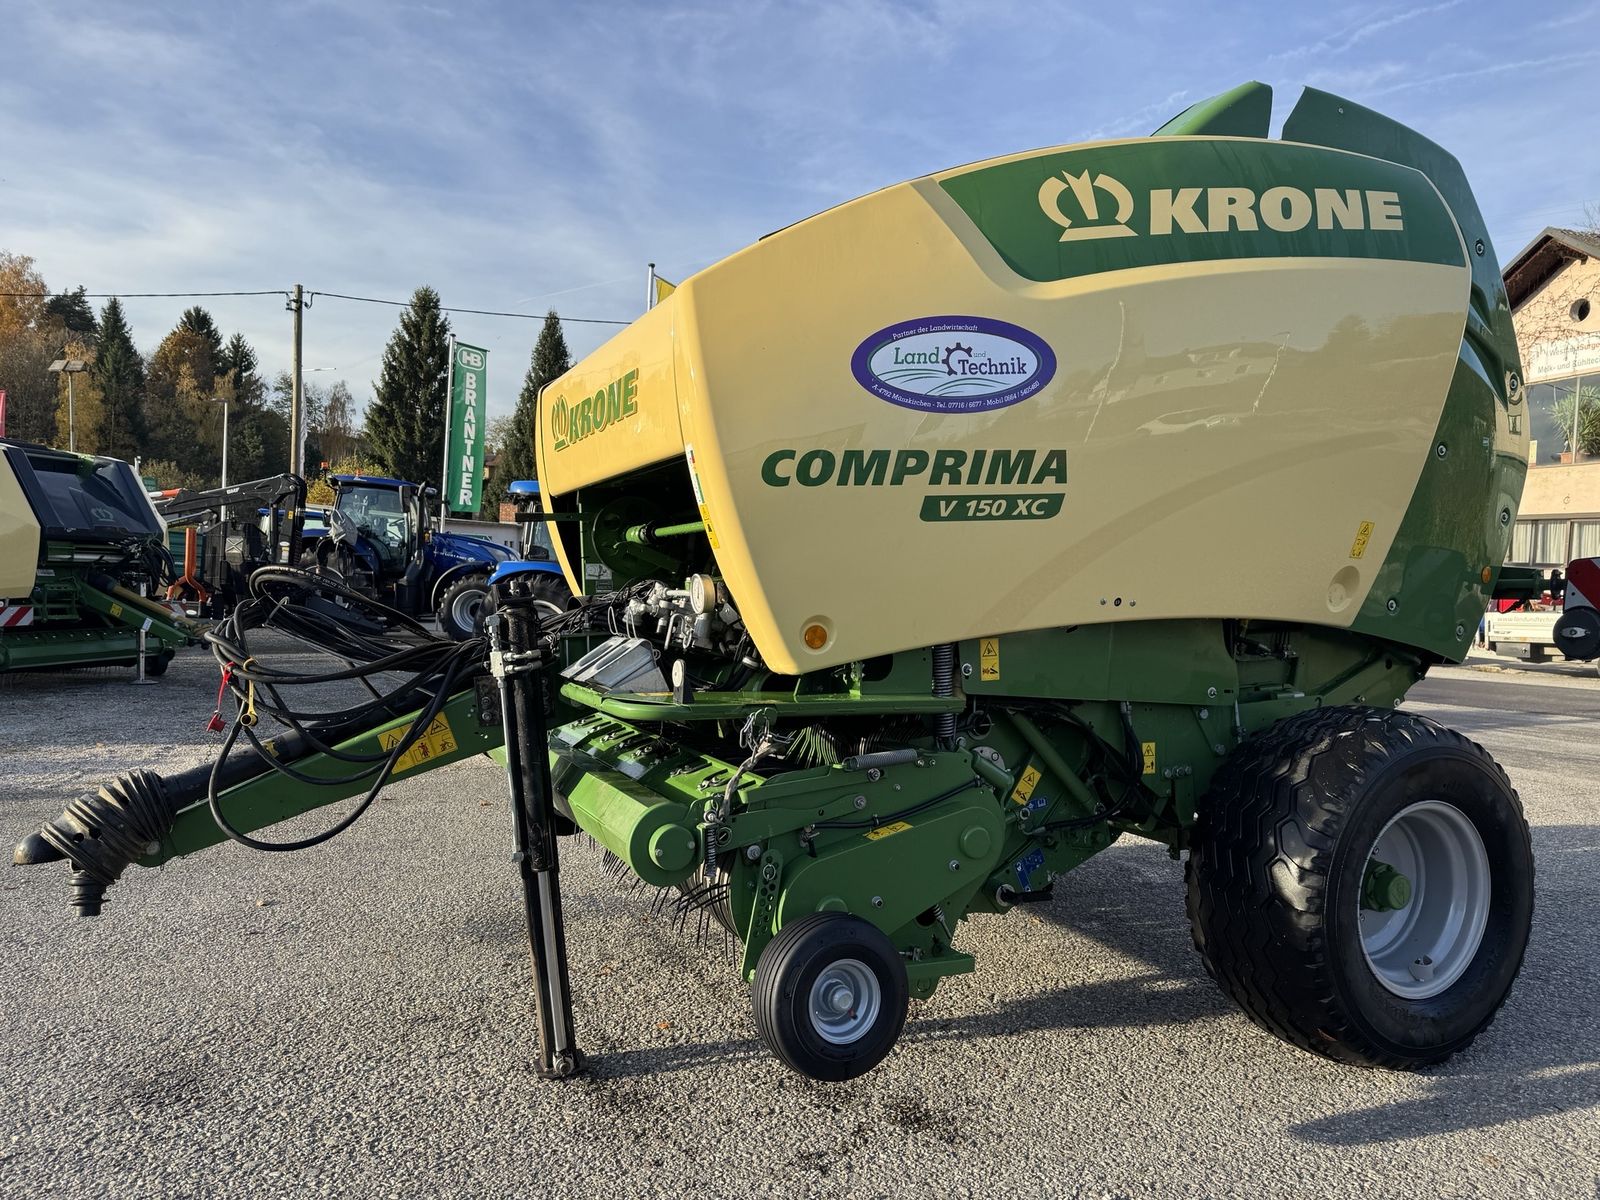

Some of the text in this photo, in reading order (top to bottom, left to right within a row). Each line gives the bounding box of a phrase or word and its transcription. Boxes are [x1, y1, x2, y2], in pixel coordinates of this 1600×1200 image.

[1150, 186, 1404, 235] KRONE
[892, 329, 916, 340] Partner
[929, 324, 978, 332] Landwirtschaft
[461, 350, 482, 368] HB
[893, 347, 940, 365] Land
[957, 357, 1027, 375] Technik
[569, 368, 639, 444] KRONE
[986, 397, 1003, 406] Mobil
[459, 372, 477, 506] BRANTNER
[761, 449, 1068, 487] COMPRIMA
[939, 498, 1049, 517] V 150 XC
